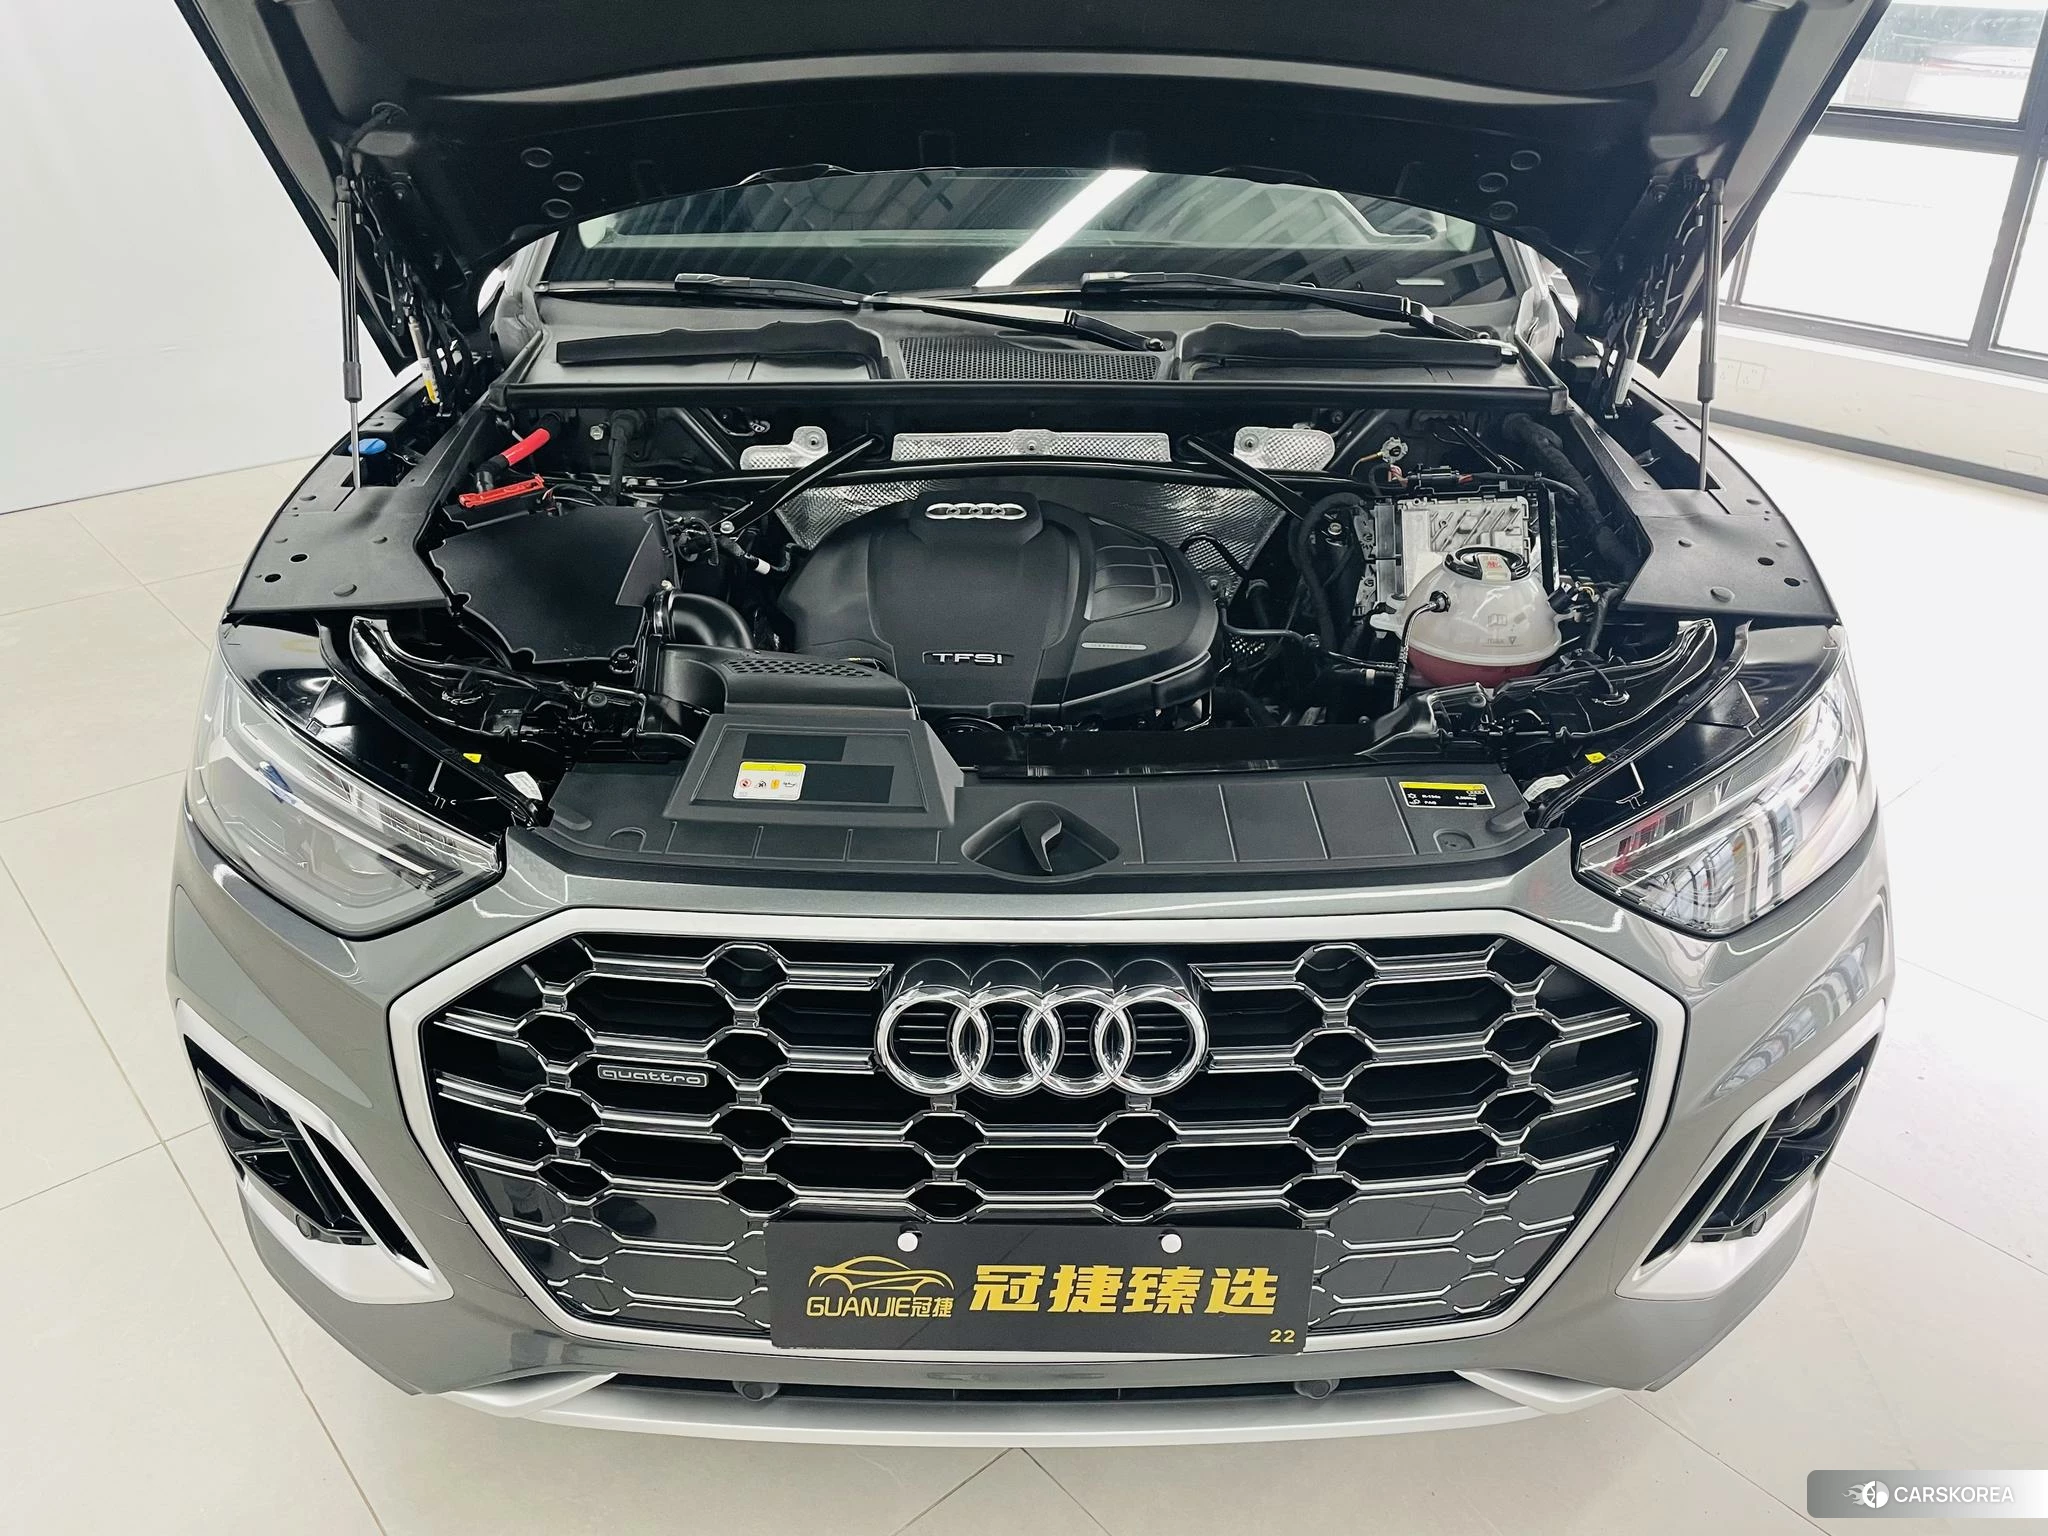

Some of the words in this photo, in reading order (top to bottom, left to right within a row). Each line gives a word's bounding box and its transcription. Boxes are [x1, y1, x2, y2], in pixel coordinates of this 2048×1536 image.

[931, 652, 1003, 665] TFSI
[602, 1069, 701, 1084] quattro
[969, 1264, 1279, 1315] 冠捷臻选
[1269, 1328, 1296, 1344] 22
